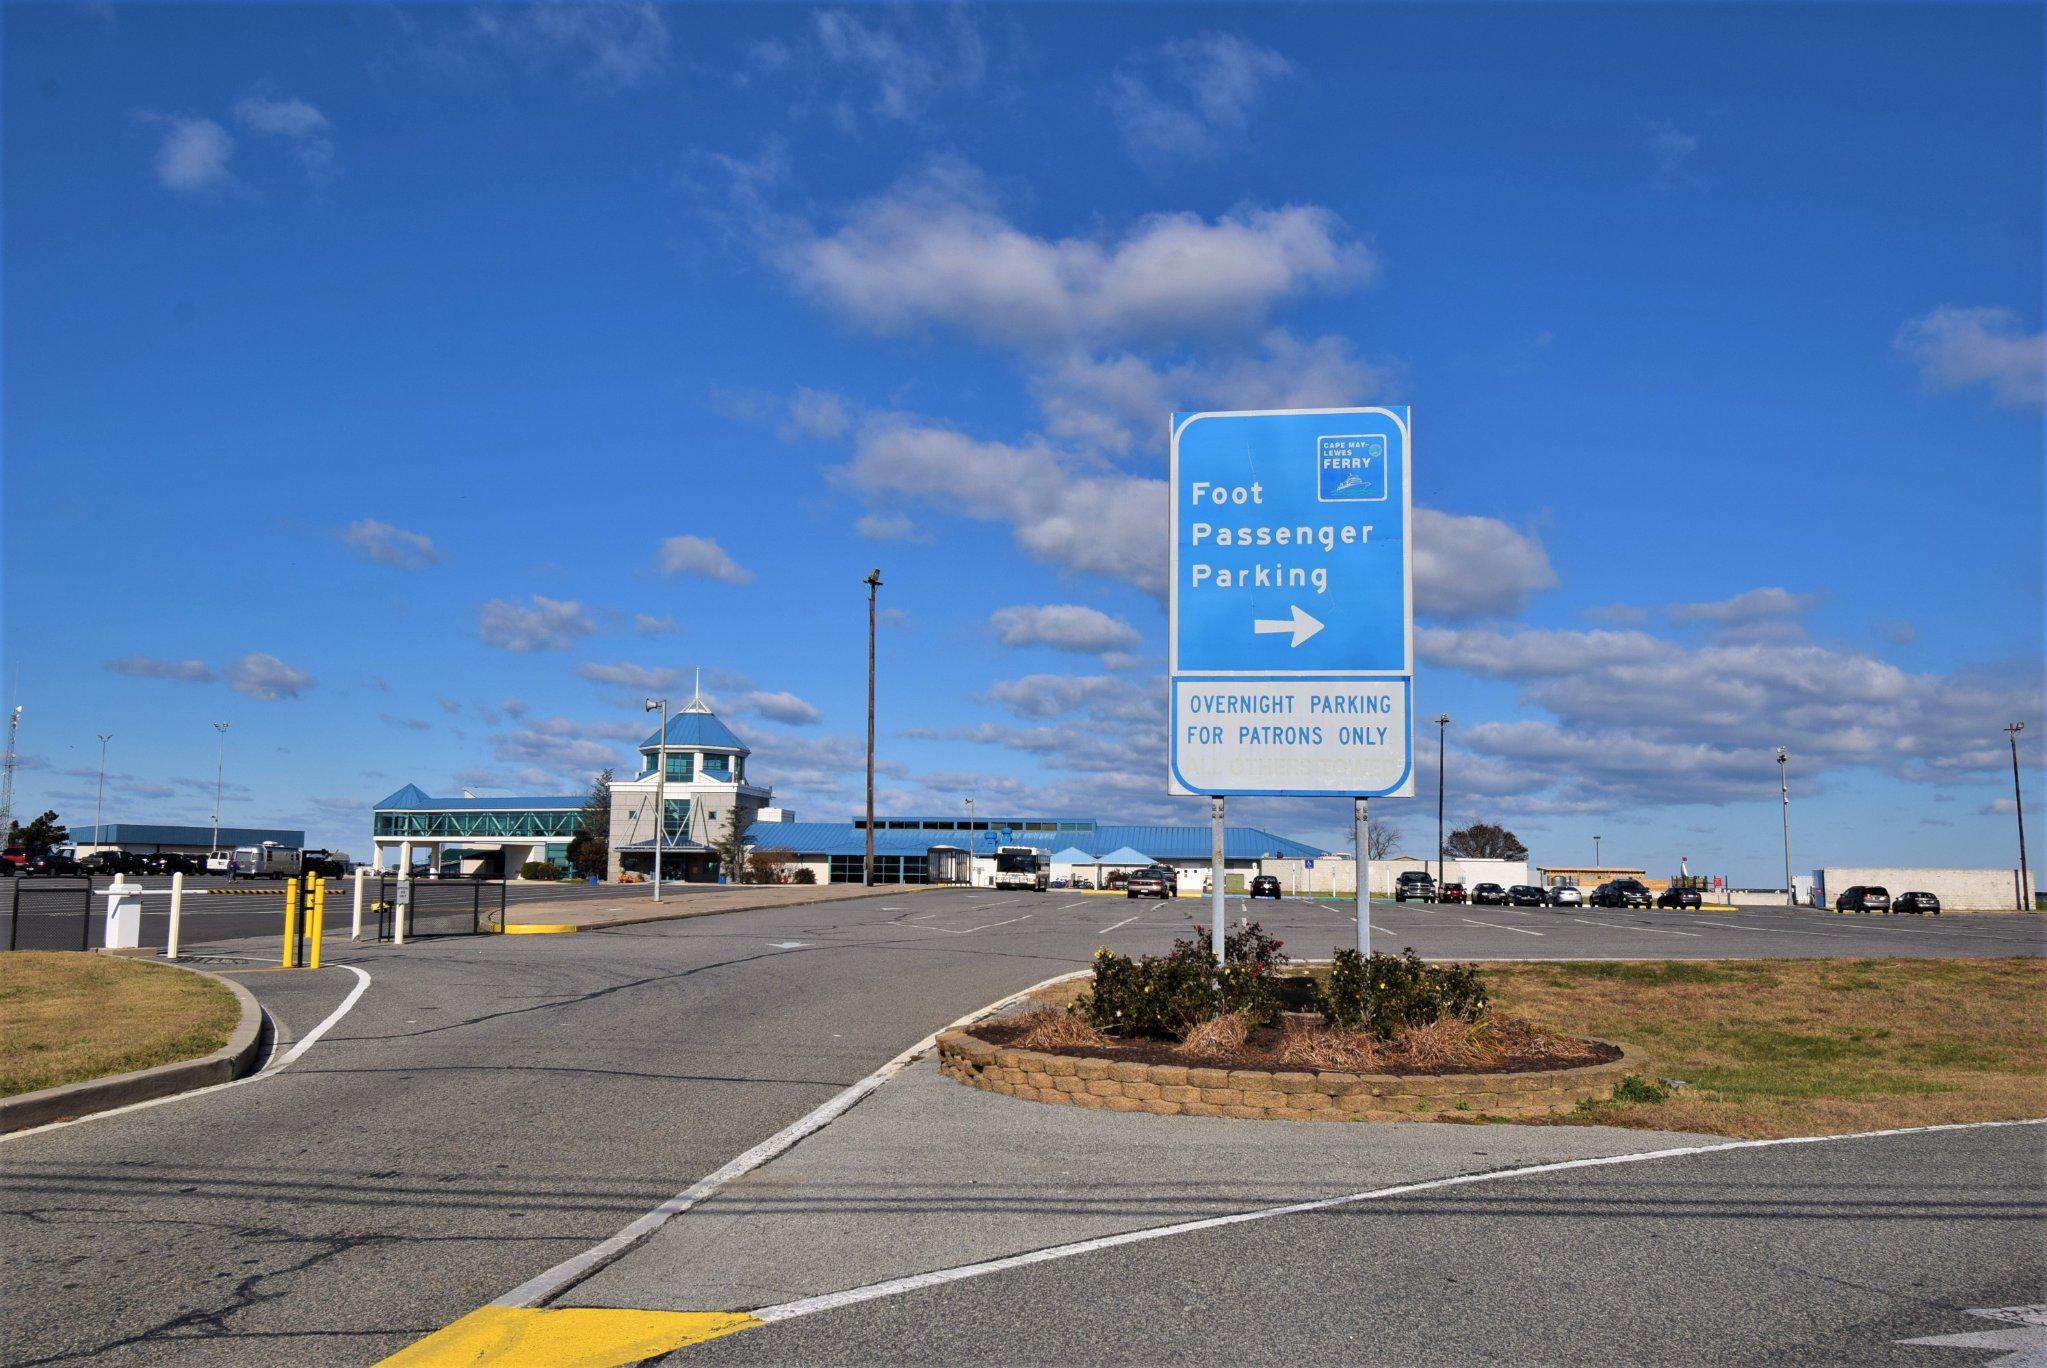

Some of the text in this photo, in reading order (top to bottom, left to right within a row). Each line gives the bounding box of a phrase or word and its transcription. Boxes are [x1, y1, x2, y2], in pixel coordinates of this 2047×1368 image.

[1323, 449, 1352, 457] LEWES
[1323, 458, 1371, 469] FERRY
[1192, 482, 1263, 505] Foot
[1192, 523, 1374, 552] Passenger
[1192, 564, 1328, 594] Parking
[1190, 695, 1391, 714] OVERNIGHT PARKING
[1187, 726, 1388, 745] FOR PATRONS ONLY
